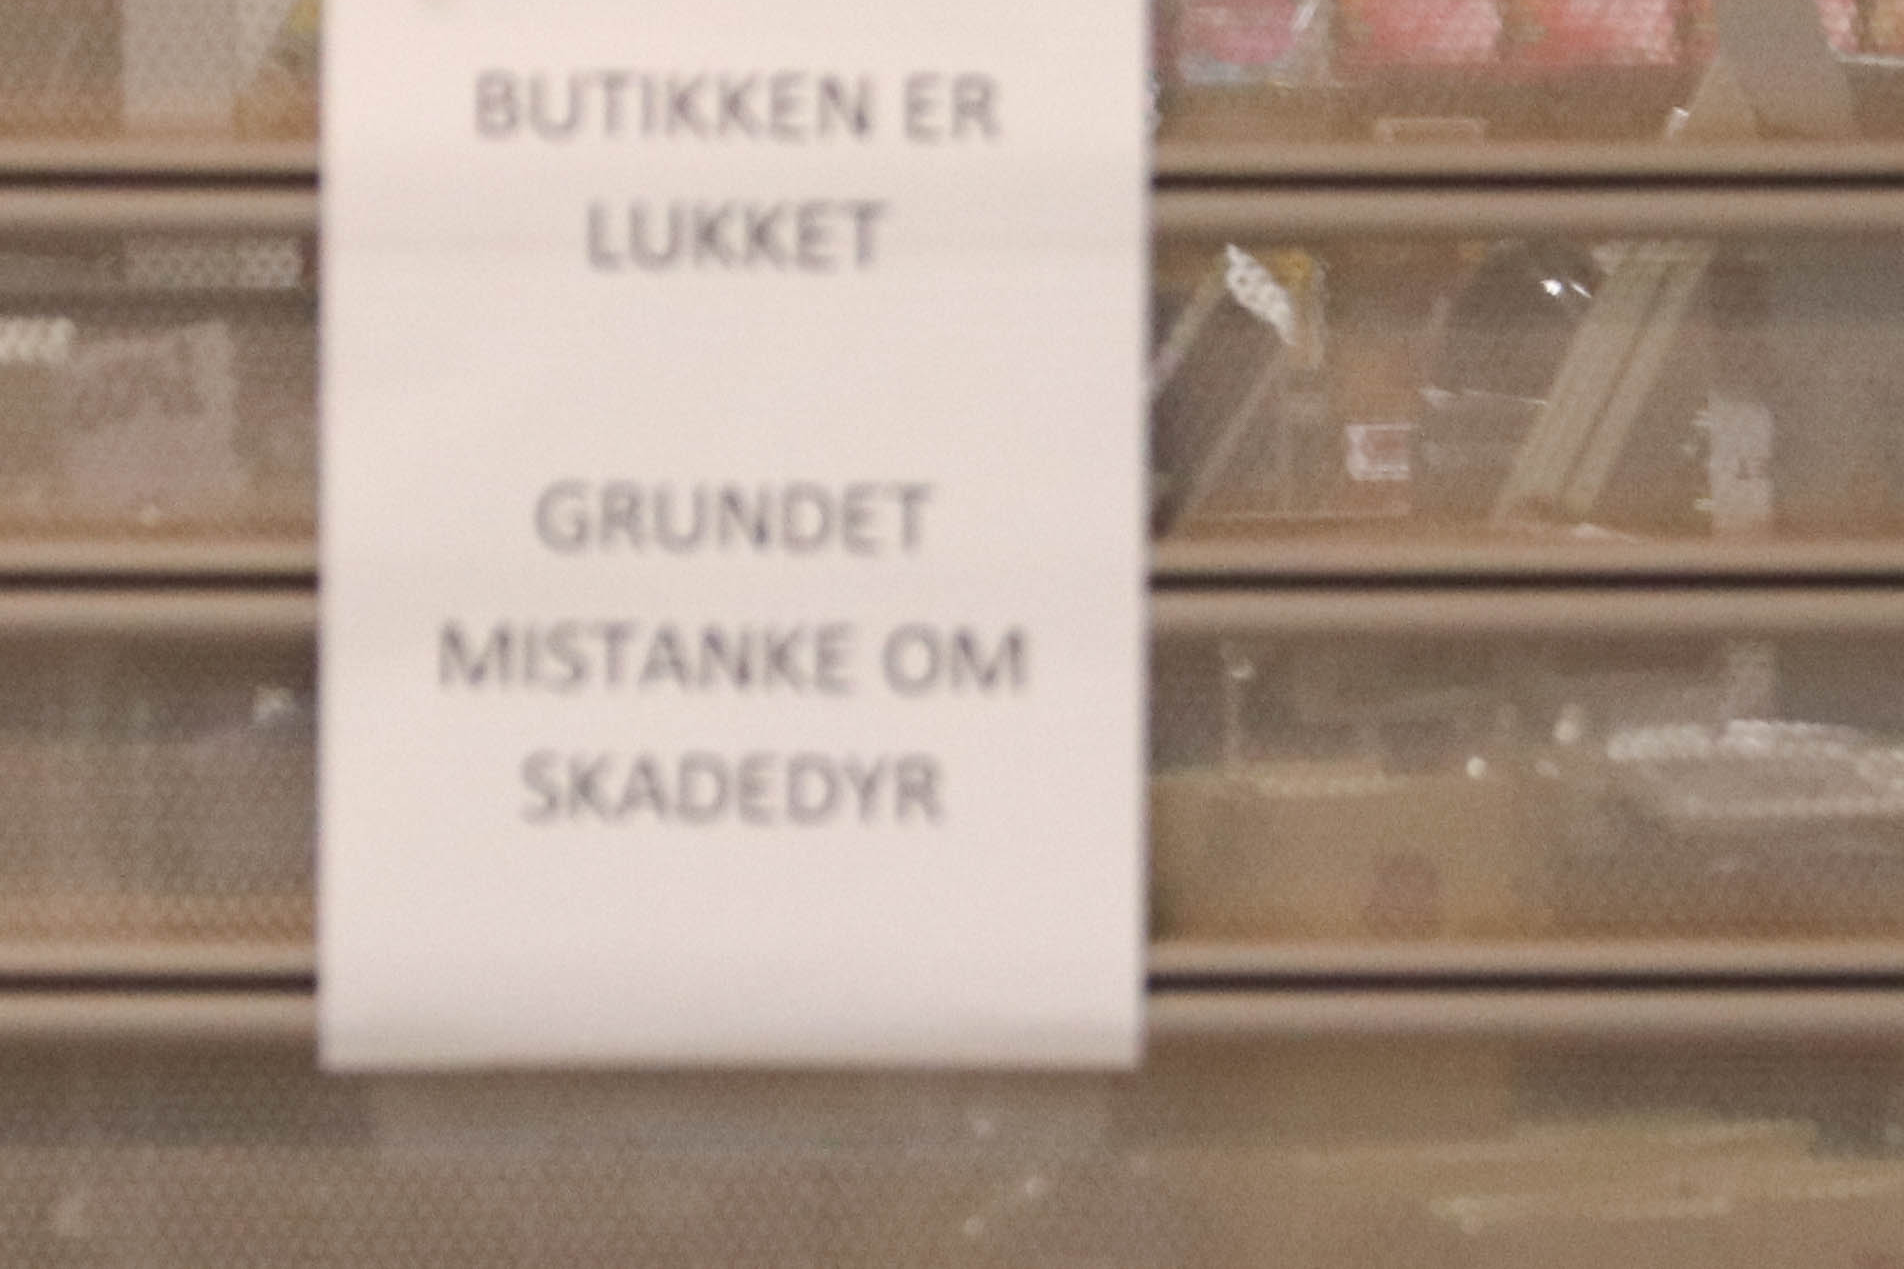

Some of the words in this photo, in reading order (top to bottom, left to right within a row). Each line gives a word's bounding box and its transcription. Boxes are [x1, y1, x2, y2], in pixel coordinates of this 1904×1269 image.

[476, 72, 873, 141] BUTIKKEN
[903, 74, 998, 143] ER
[586, 199, 886, 271] LUKKET
[534, 481, 929, 555] GRUNDET
[438, 620, 849, 693] MISTANKE
[881, 624, 1028, 695] OM
[521, 752, 941, 825] SKADEDYR
